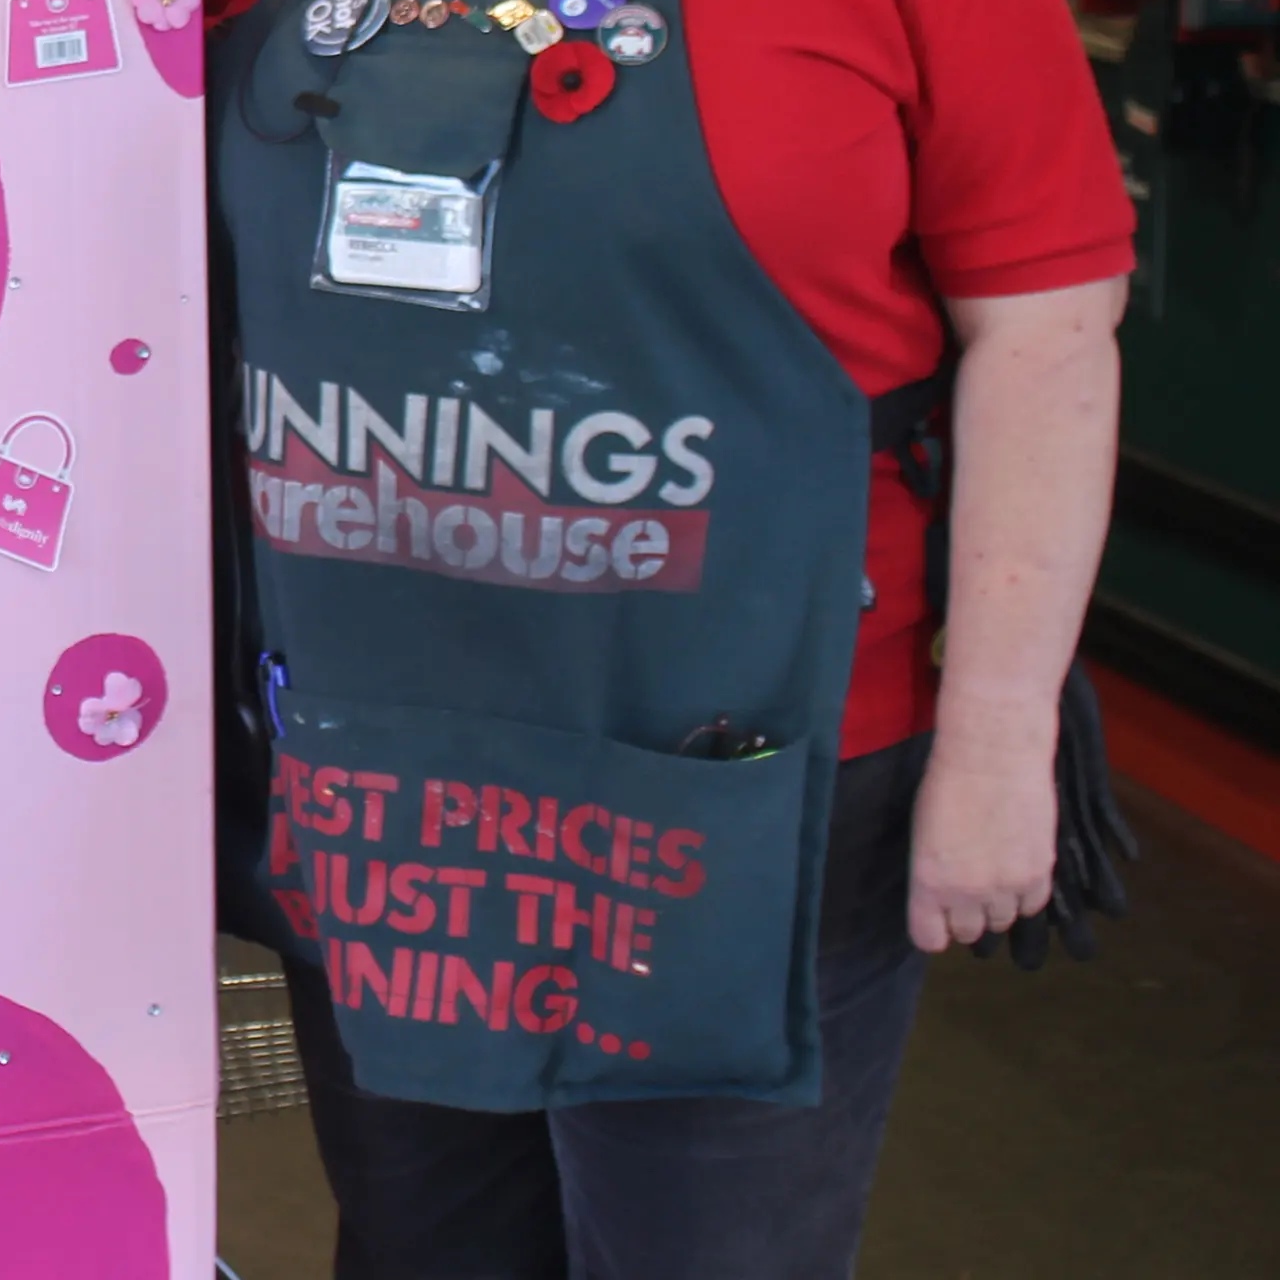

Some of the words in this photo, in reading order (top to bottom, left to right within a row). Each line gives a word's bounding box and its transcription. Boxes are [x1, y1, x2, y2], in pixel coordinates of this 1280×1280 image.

[306, 0, 332, 42] OK
[244, 362, 714, 506] UNNINGS
[251, 460, 670, 582] arehouse
[421, 778, 707, 899] PRICES
[505, 873, 656, 977] THE
